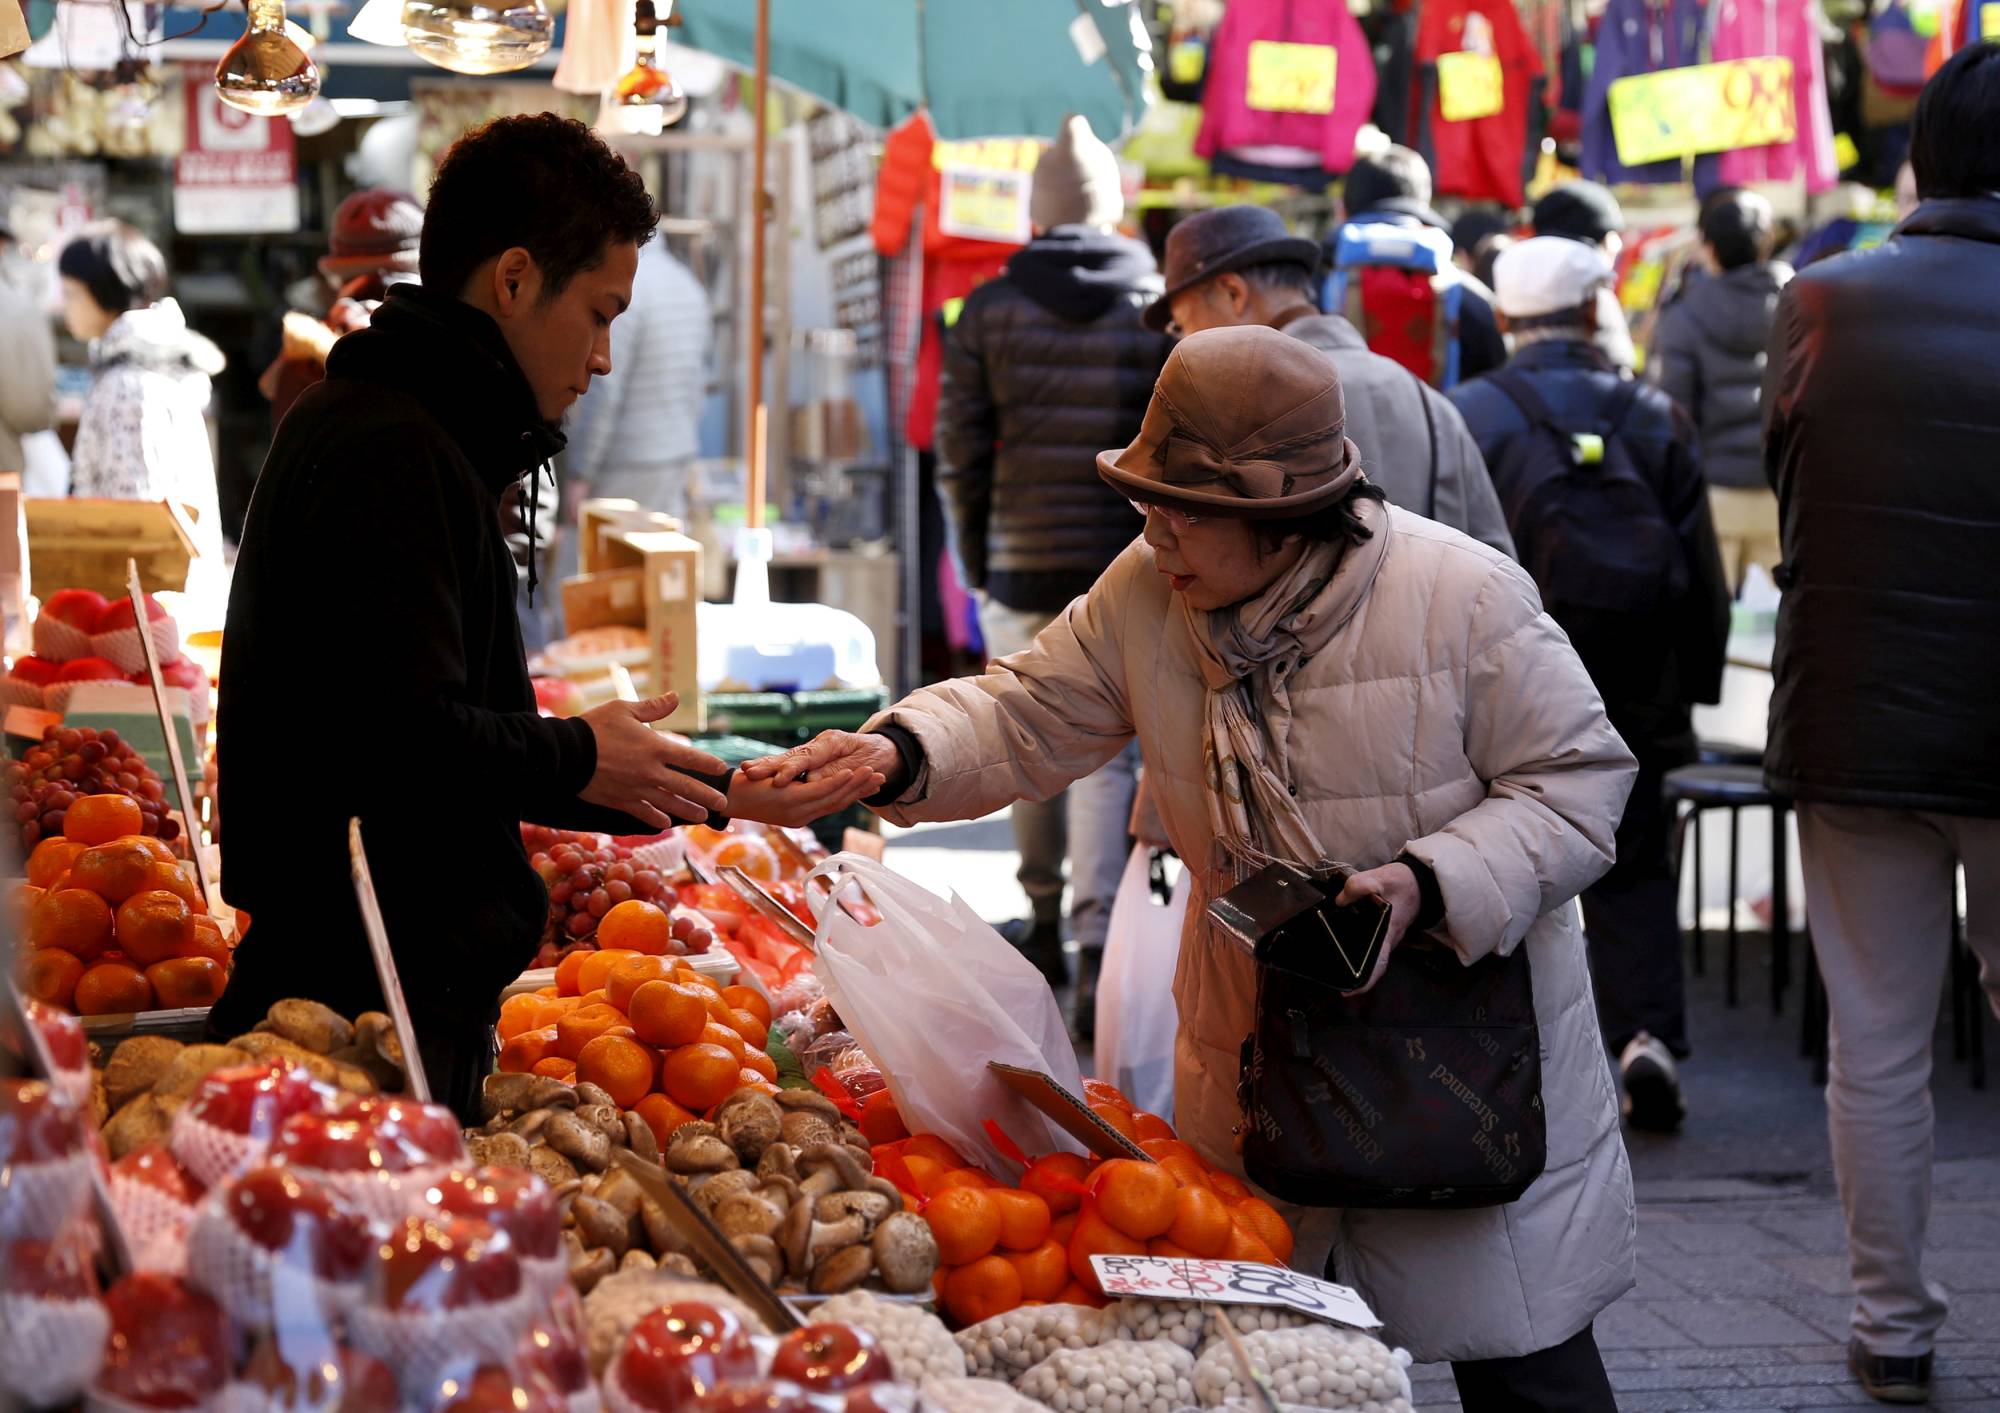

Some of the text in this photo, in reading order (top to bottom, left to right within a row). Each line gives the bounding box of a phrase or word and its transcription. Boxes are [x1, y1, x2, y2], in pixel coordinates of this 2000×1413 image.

[1312, 1055, 1384, 1130] Streamed
[1428, 1064, 1500, 1132] Streamed
[1334, 1105, 1385, 1167] Ribbon
[1471, 1129, 1522, 1185] Ribbon
